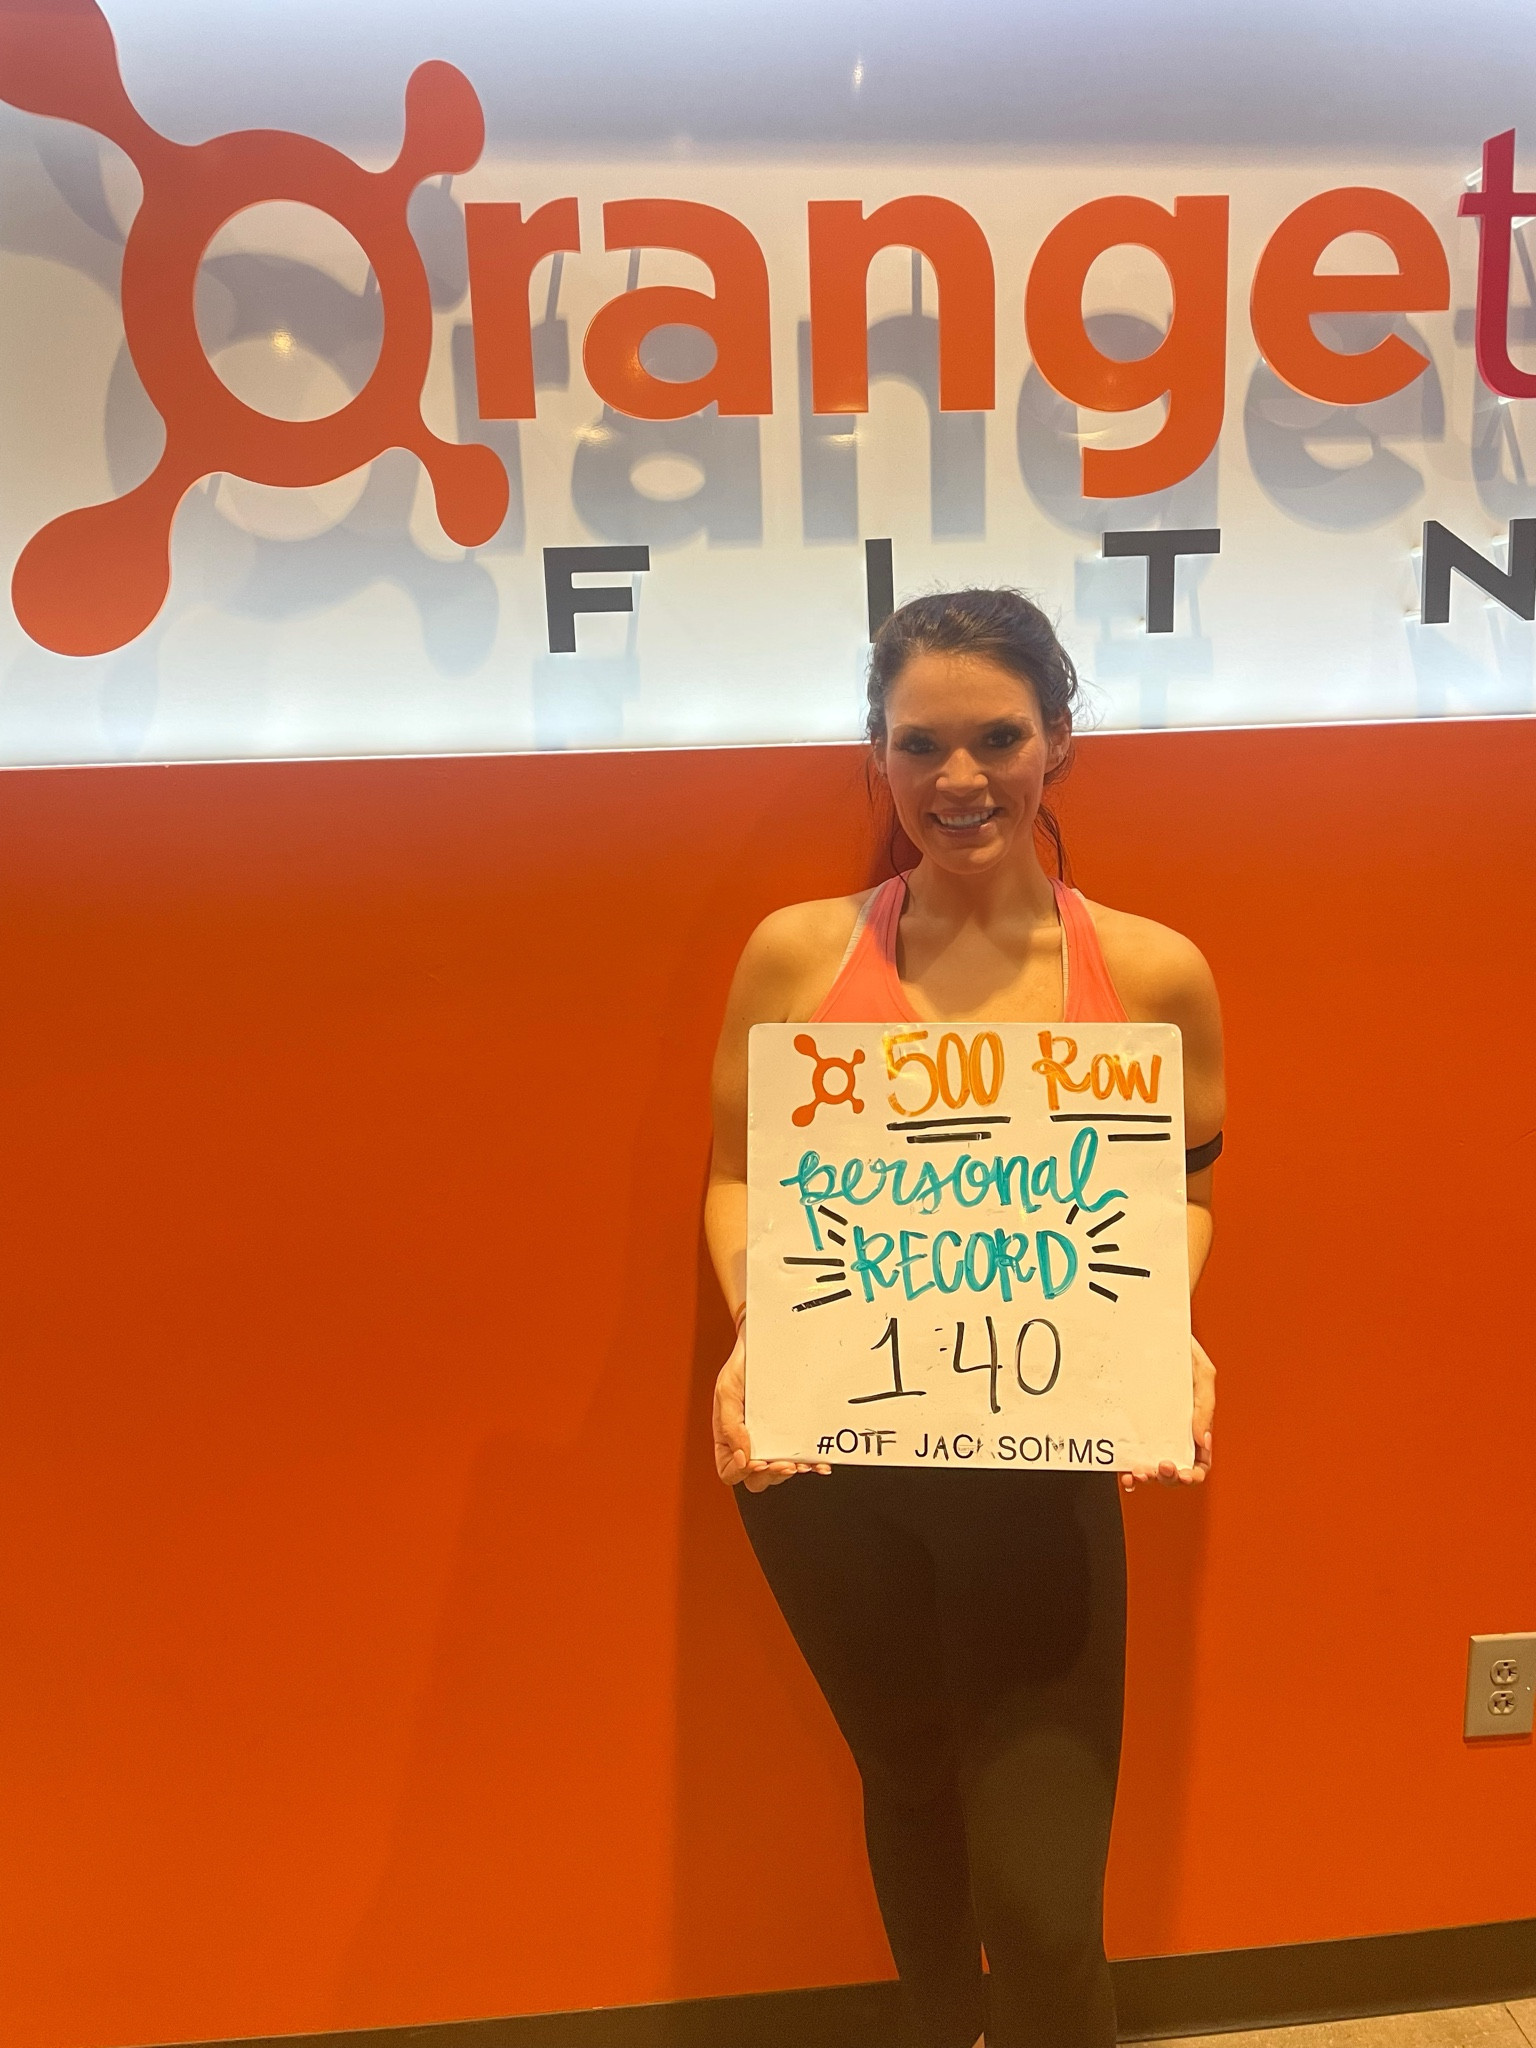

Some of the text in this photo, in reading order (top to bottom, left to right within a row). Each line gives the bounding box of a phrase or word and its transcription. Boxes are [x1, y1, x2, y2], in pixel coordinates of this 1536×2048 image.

[543, 517, 1536, 654] FITN
[882, 1030, 1163, 1118] 500 Row
[780, 1127, 1128, 1251] personal
[851, 1226, 1079, 1302] RECORD
[848, 1316, 1062, 1414] 1:40
[816, 1428, 897, 1457] #OTF
